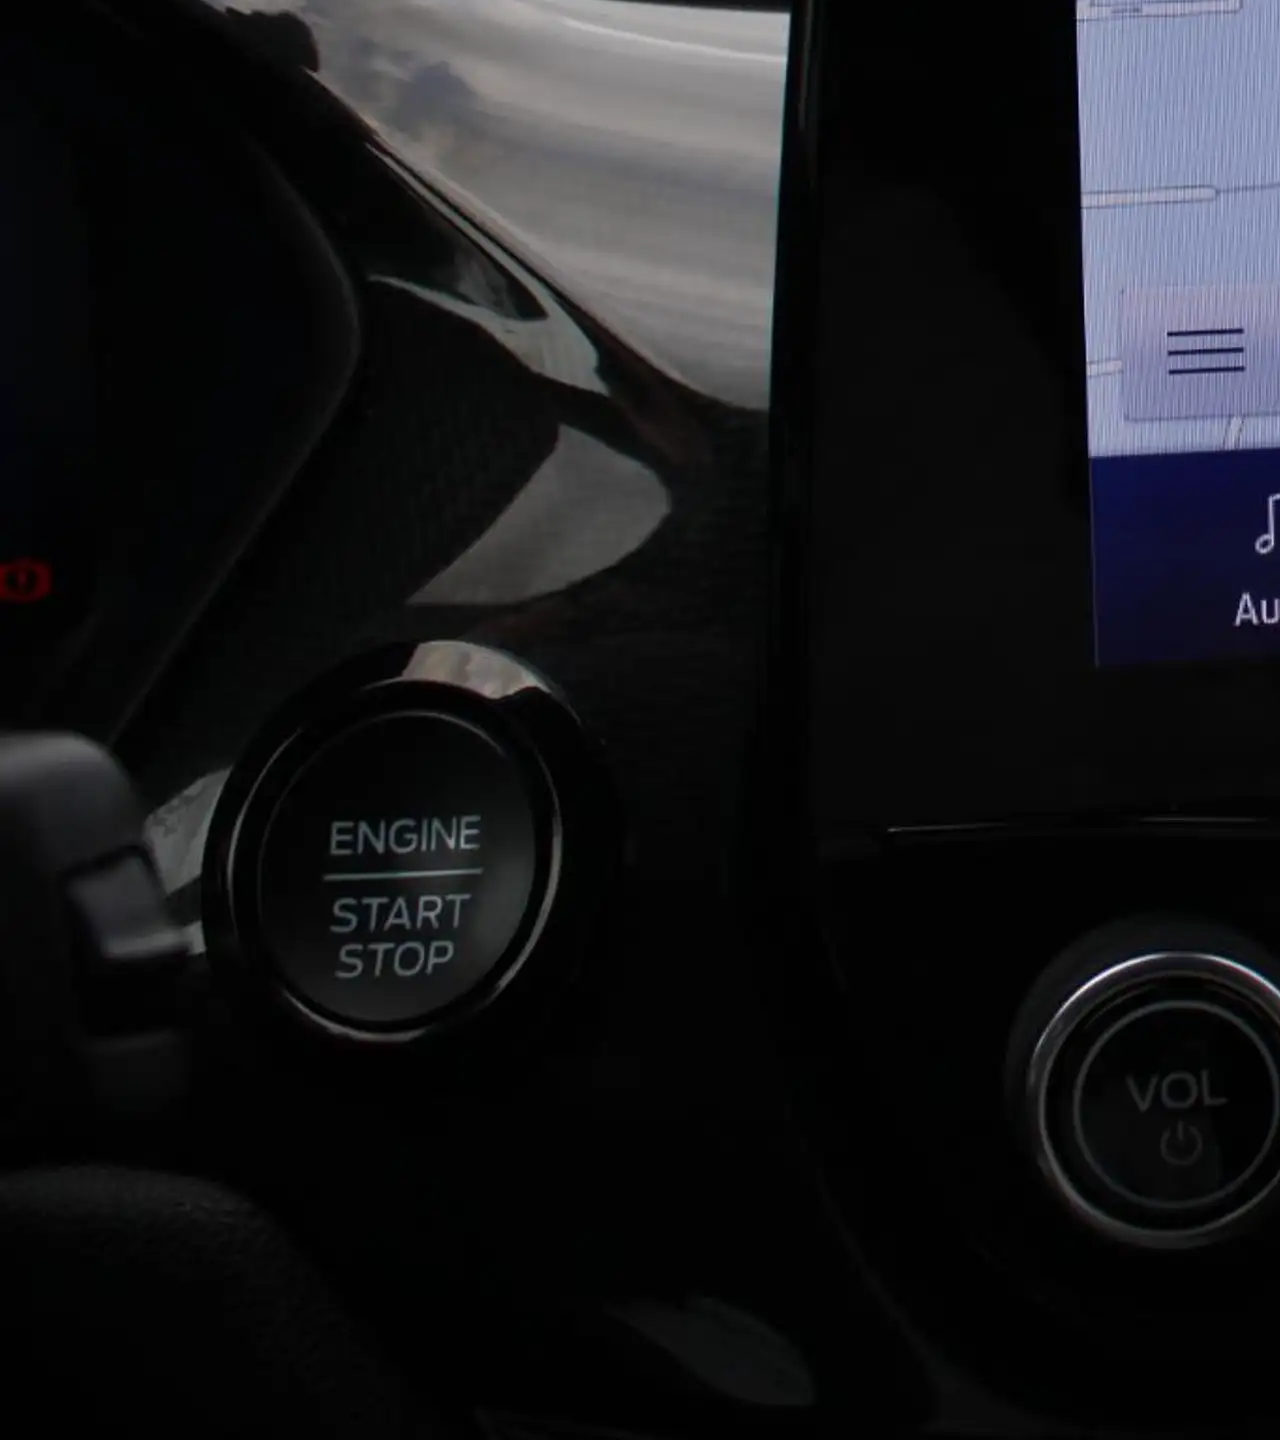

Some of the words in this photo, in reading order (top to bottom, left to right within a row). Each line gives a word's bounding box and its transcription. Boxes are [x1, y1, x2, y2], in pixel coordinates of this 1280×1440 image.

[328, 815, 482, 856] ENGINE
[329, 893, 471, 934] START
[334, 940, 456, 980] STOP
[1125, 1068, 1229, 1112] VOL
